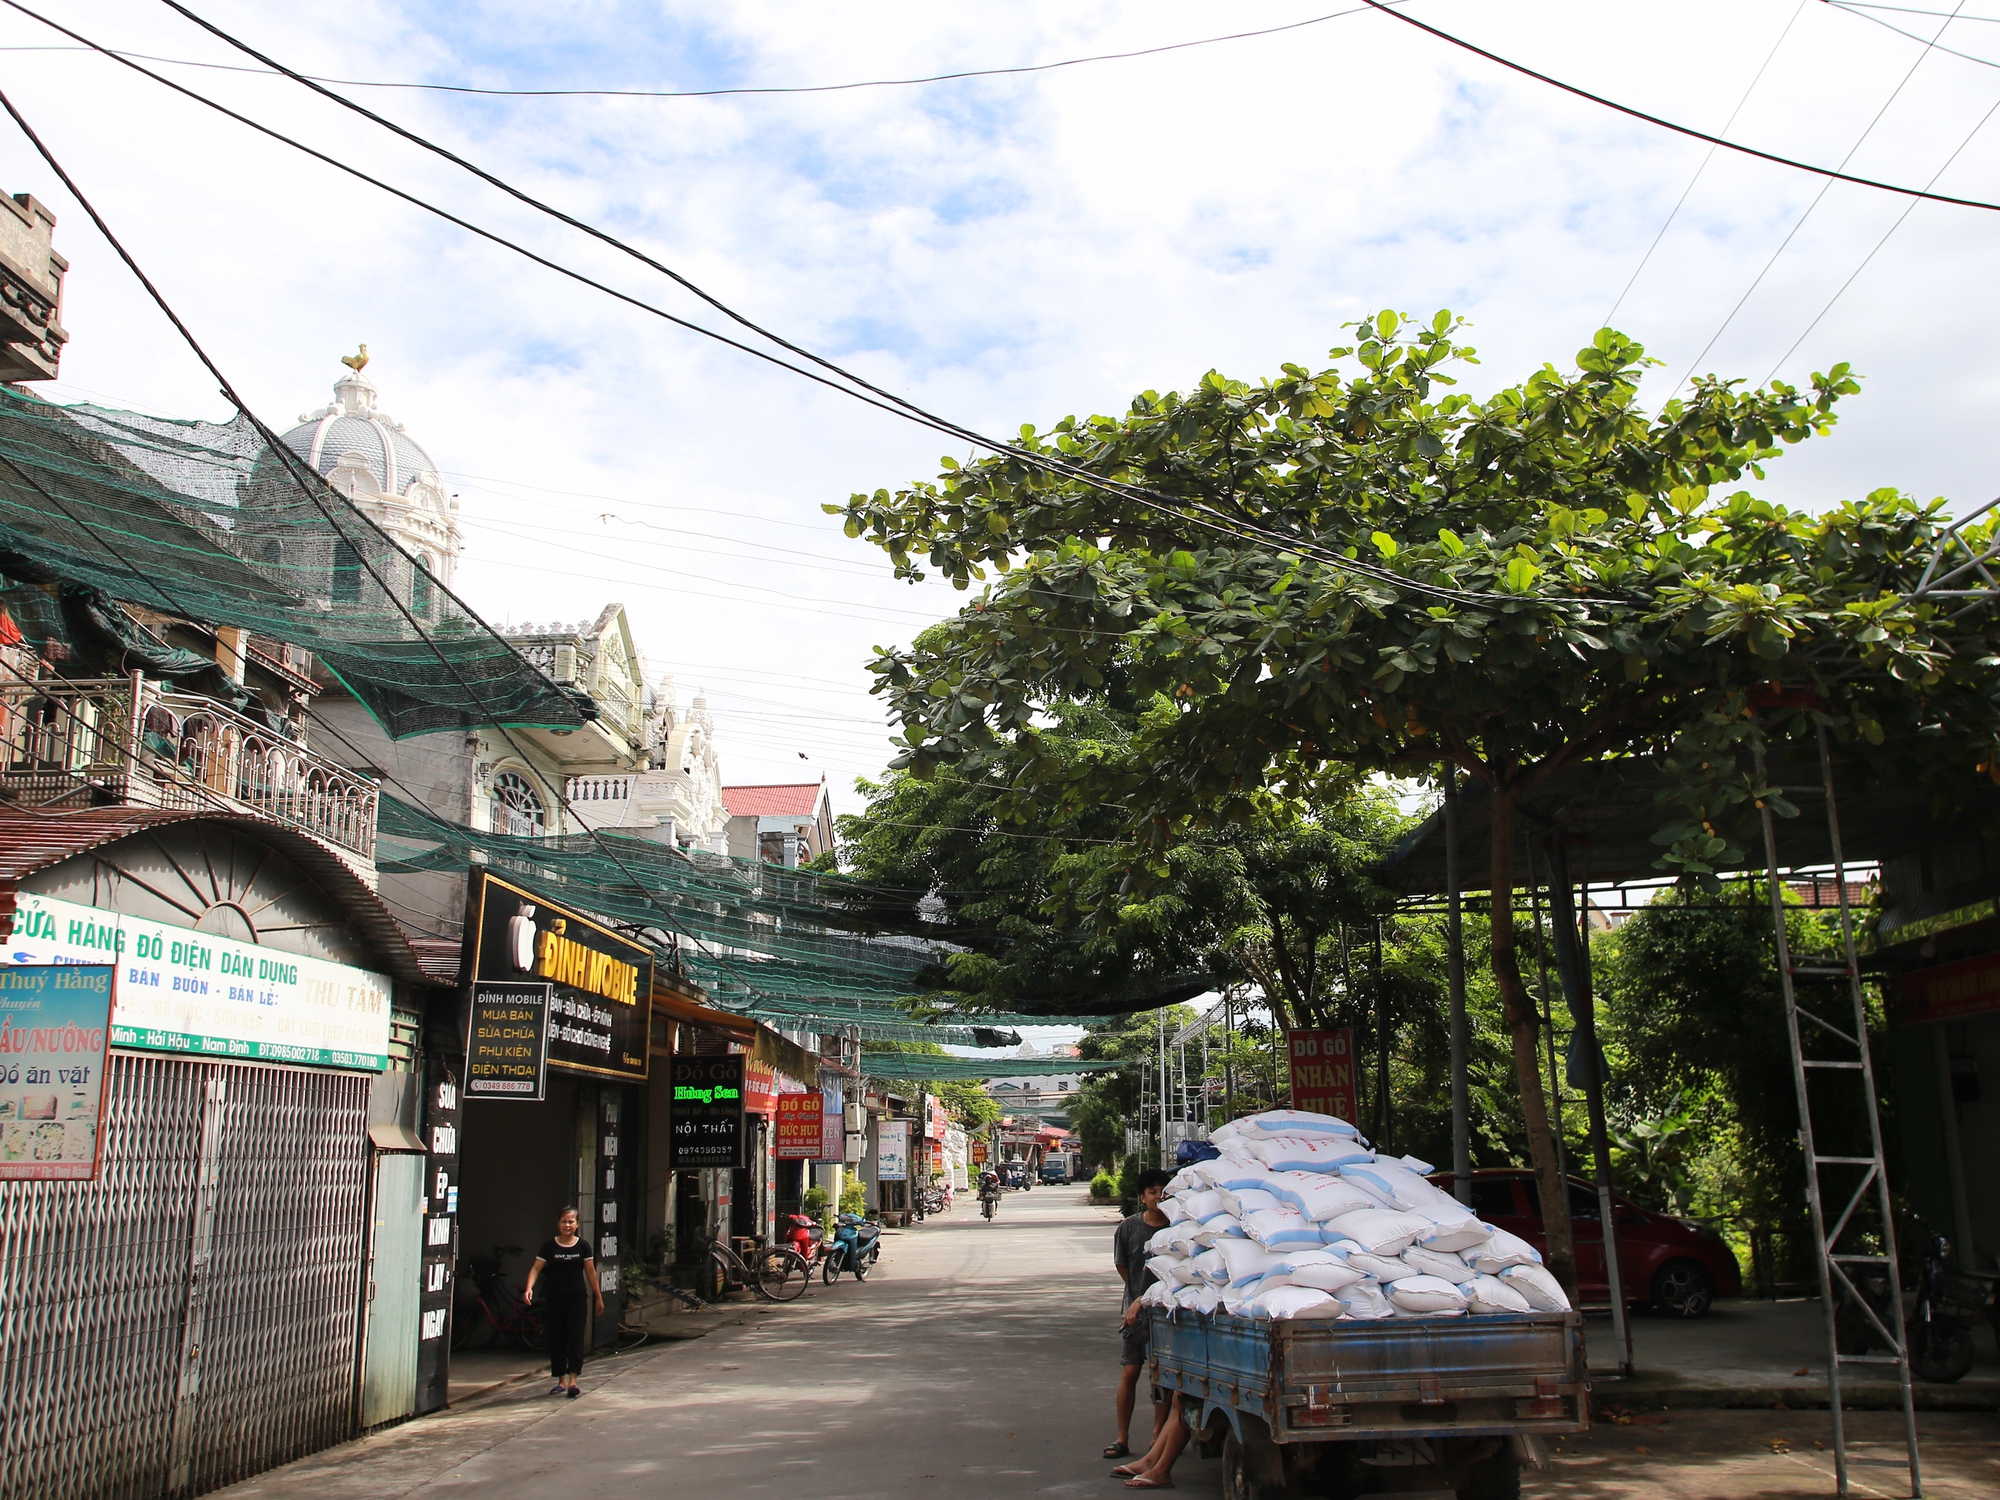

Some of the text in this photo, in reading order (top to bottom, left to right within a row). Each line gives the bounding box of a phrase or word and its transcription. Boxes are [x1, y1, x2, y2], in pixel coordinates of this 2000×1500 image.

[12, 899, 298, 986] CỬA HÀNG ĐỒ ĐIỆN DÂN DỤNG
[539, 918, 638, 1006] ĐỈNH MOBILE
[0, 966, 108, 993] Thuý Hằng
[129, 966, 160, 987] BÁN
[173, 976, 209, 995] BUÔN
[229, 983, 254, 1003] BÁN
[305, 977, 383, 1015] THU TÂM
[506, 994, 543, 1005] MOBILE
[482, 1008, 533, 1020] MUA BÁN
[478, 1024, 535, 1039] SỬA CHỮA
[146, 1030, 166, 1047] Hải
[168, 1033, 190, 1052] Hậu
[202, 1036, 227, 1052] Nam
[229, 1038, 250, 1057] Định
[478, 1044, 532, 1060] PHỤ KIỆN
[1322, 1033, 1347, 1055] GỖ
[26, 1065, 51, 1084] ăn
[58, 1065, 90, 1088] vặt
[471, 1061, 536, 1079] ĐIỆN THOẠI
[676, 1061, 703, 1080] Đồ
[709, 1059, 737, 1080] Gỗ
[1294, 1059, 1349, 1088] NHÂN
[482, 1082, 500, 1090] 0349
[502, 1082, 515, 1090] 886
[674, 1086, 712, 1104] Hùng
[714, 1085, 739, 1099] Sen
[803, 1096, 820, 1111] GỖ
[675, 1118, 735, 1137] NỘI THẤT
[780, 1122, 819, 1136] ĐỨC HUY
[435, 1166, 449, 1200] ÉP
[428, 1212, 450, 1246] KÍNH
[422, 1308, 446, 1340] NGAY
